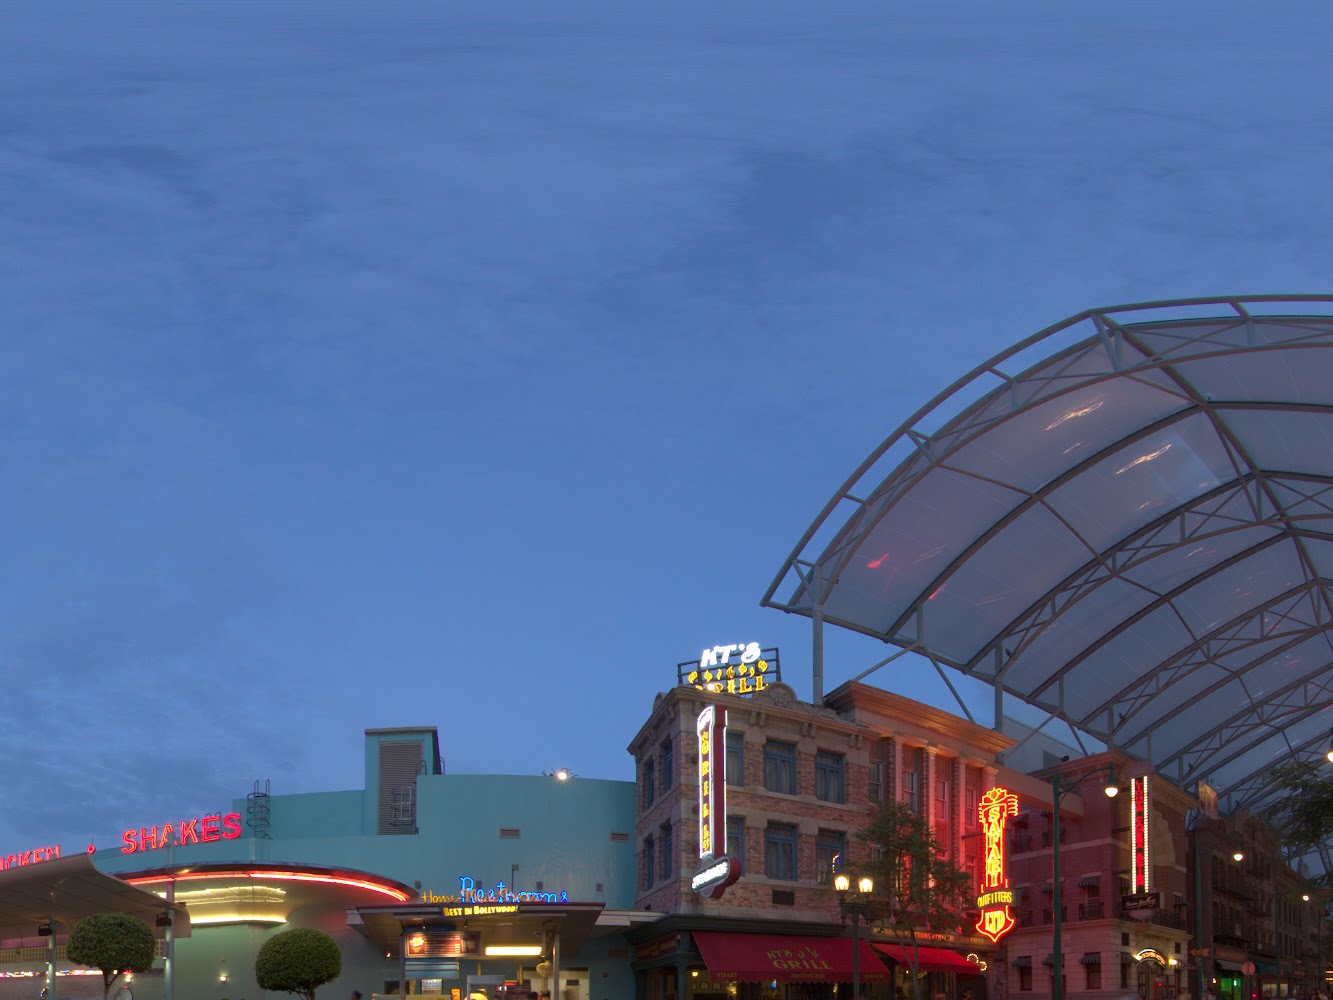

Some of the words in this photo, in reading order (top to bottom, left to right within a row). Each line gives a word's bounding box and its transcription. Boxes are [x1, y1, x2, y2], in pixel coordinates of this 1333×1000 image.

[121, 813, 242, 854] SHAKES
[977, 891, 1012, 908] OUTFITTERS
[444, 907, 463, 917] BEST
[465, 906, 472, 915] IN
[773, 959, 833, 970] GRILL
